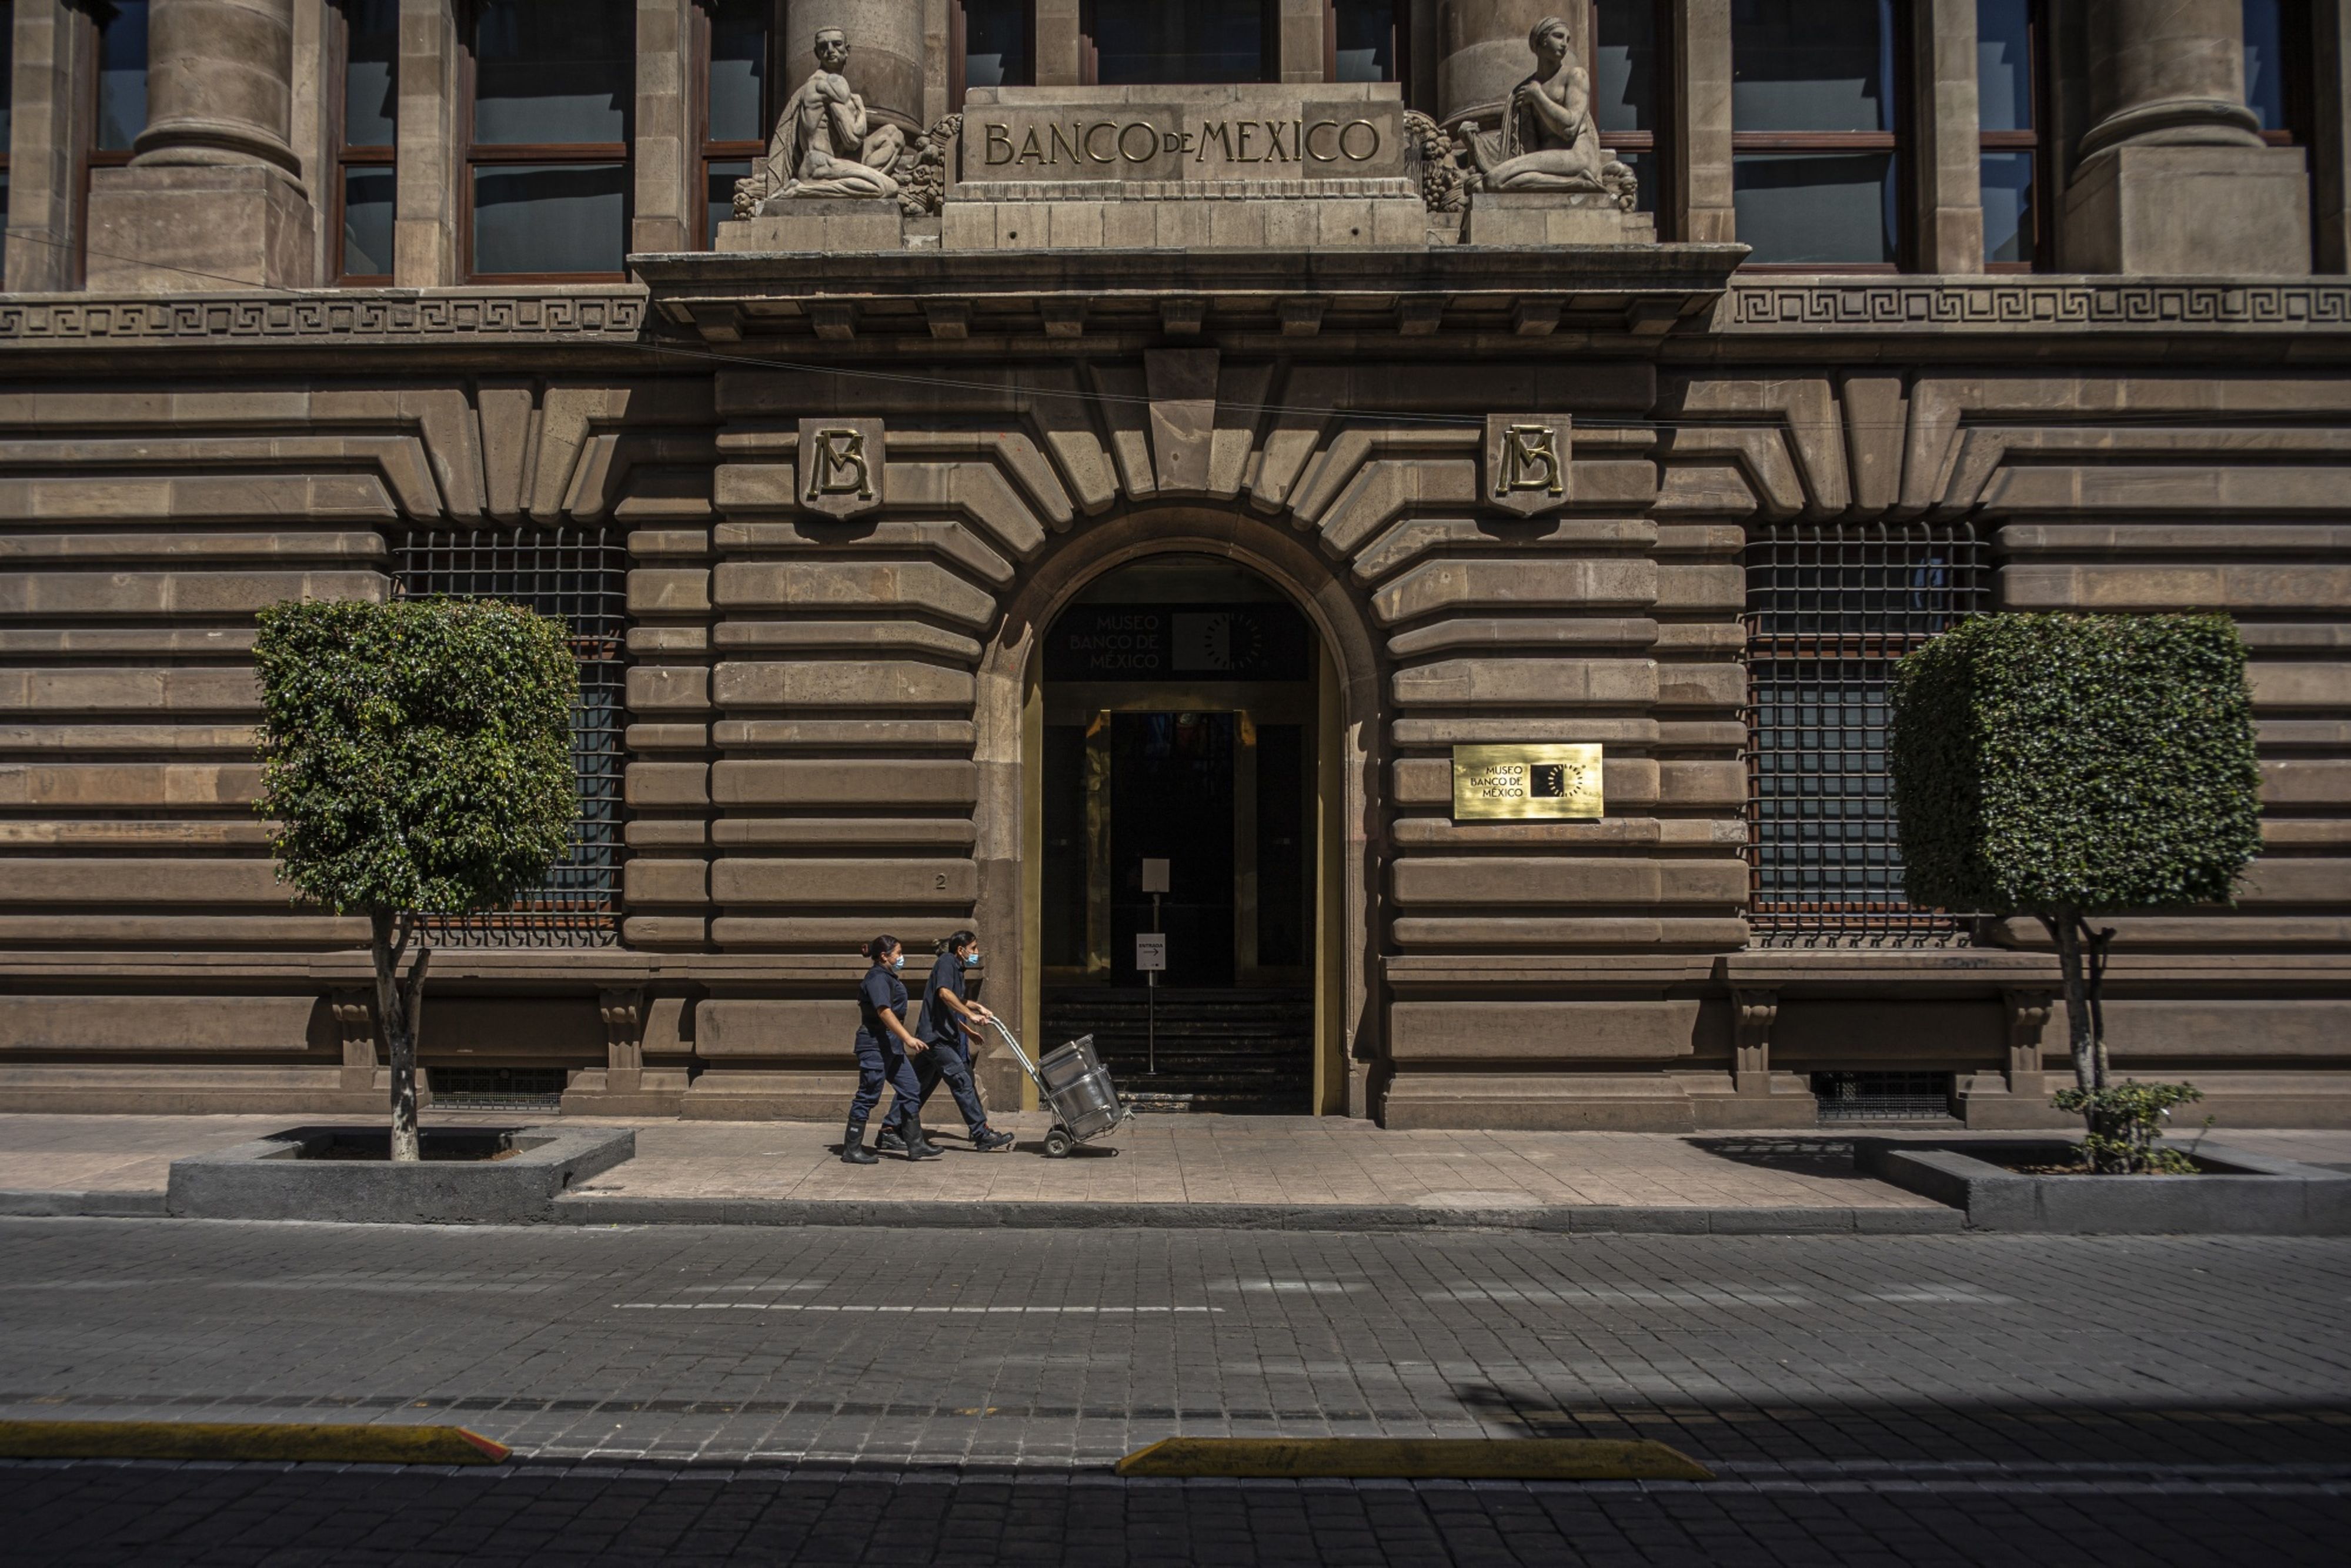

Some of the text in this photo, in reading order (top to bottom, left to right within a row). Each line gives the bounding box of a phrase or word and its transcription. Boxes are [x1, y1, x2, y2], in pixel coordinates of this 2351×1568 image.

[984, 119, 1381, 165] BANCO DE MEXICO
[1096, 615, 1159, 630] MUSEO
[1070, 634, 1159, 650] BANCO DE
[1090, 650, 1159, 668] MÉXICO
[1485, 765, 1523, 774] MUSEO
[1470, 777, 1523, 787] BANCO DE
[1482, 787, 1524, 797] MÉXICO
[936, 873, 946, 890] 2
